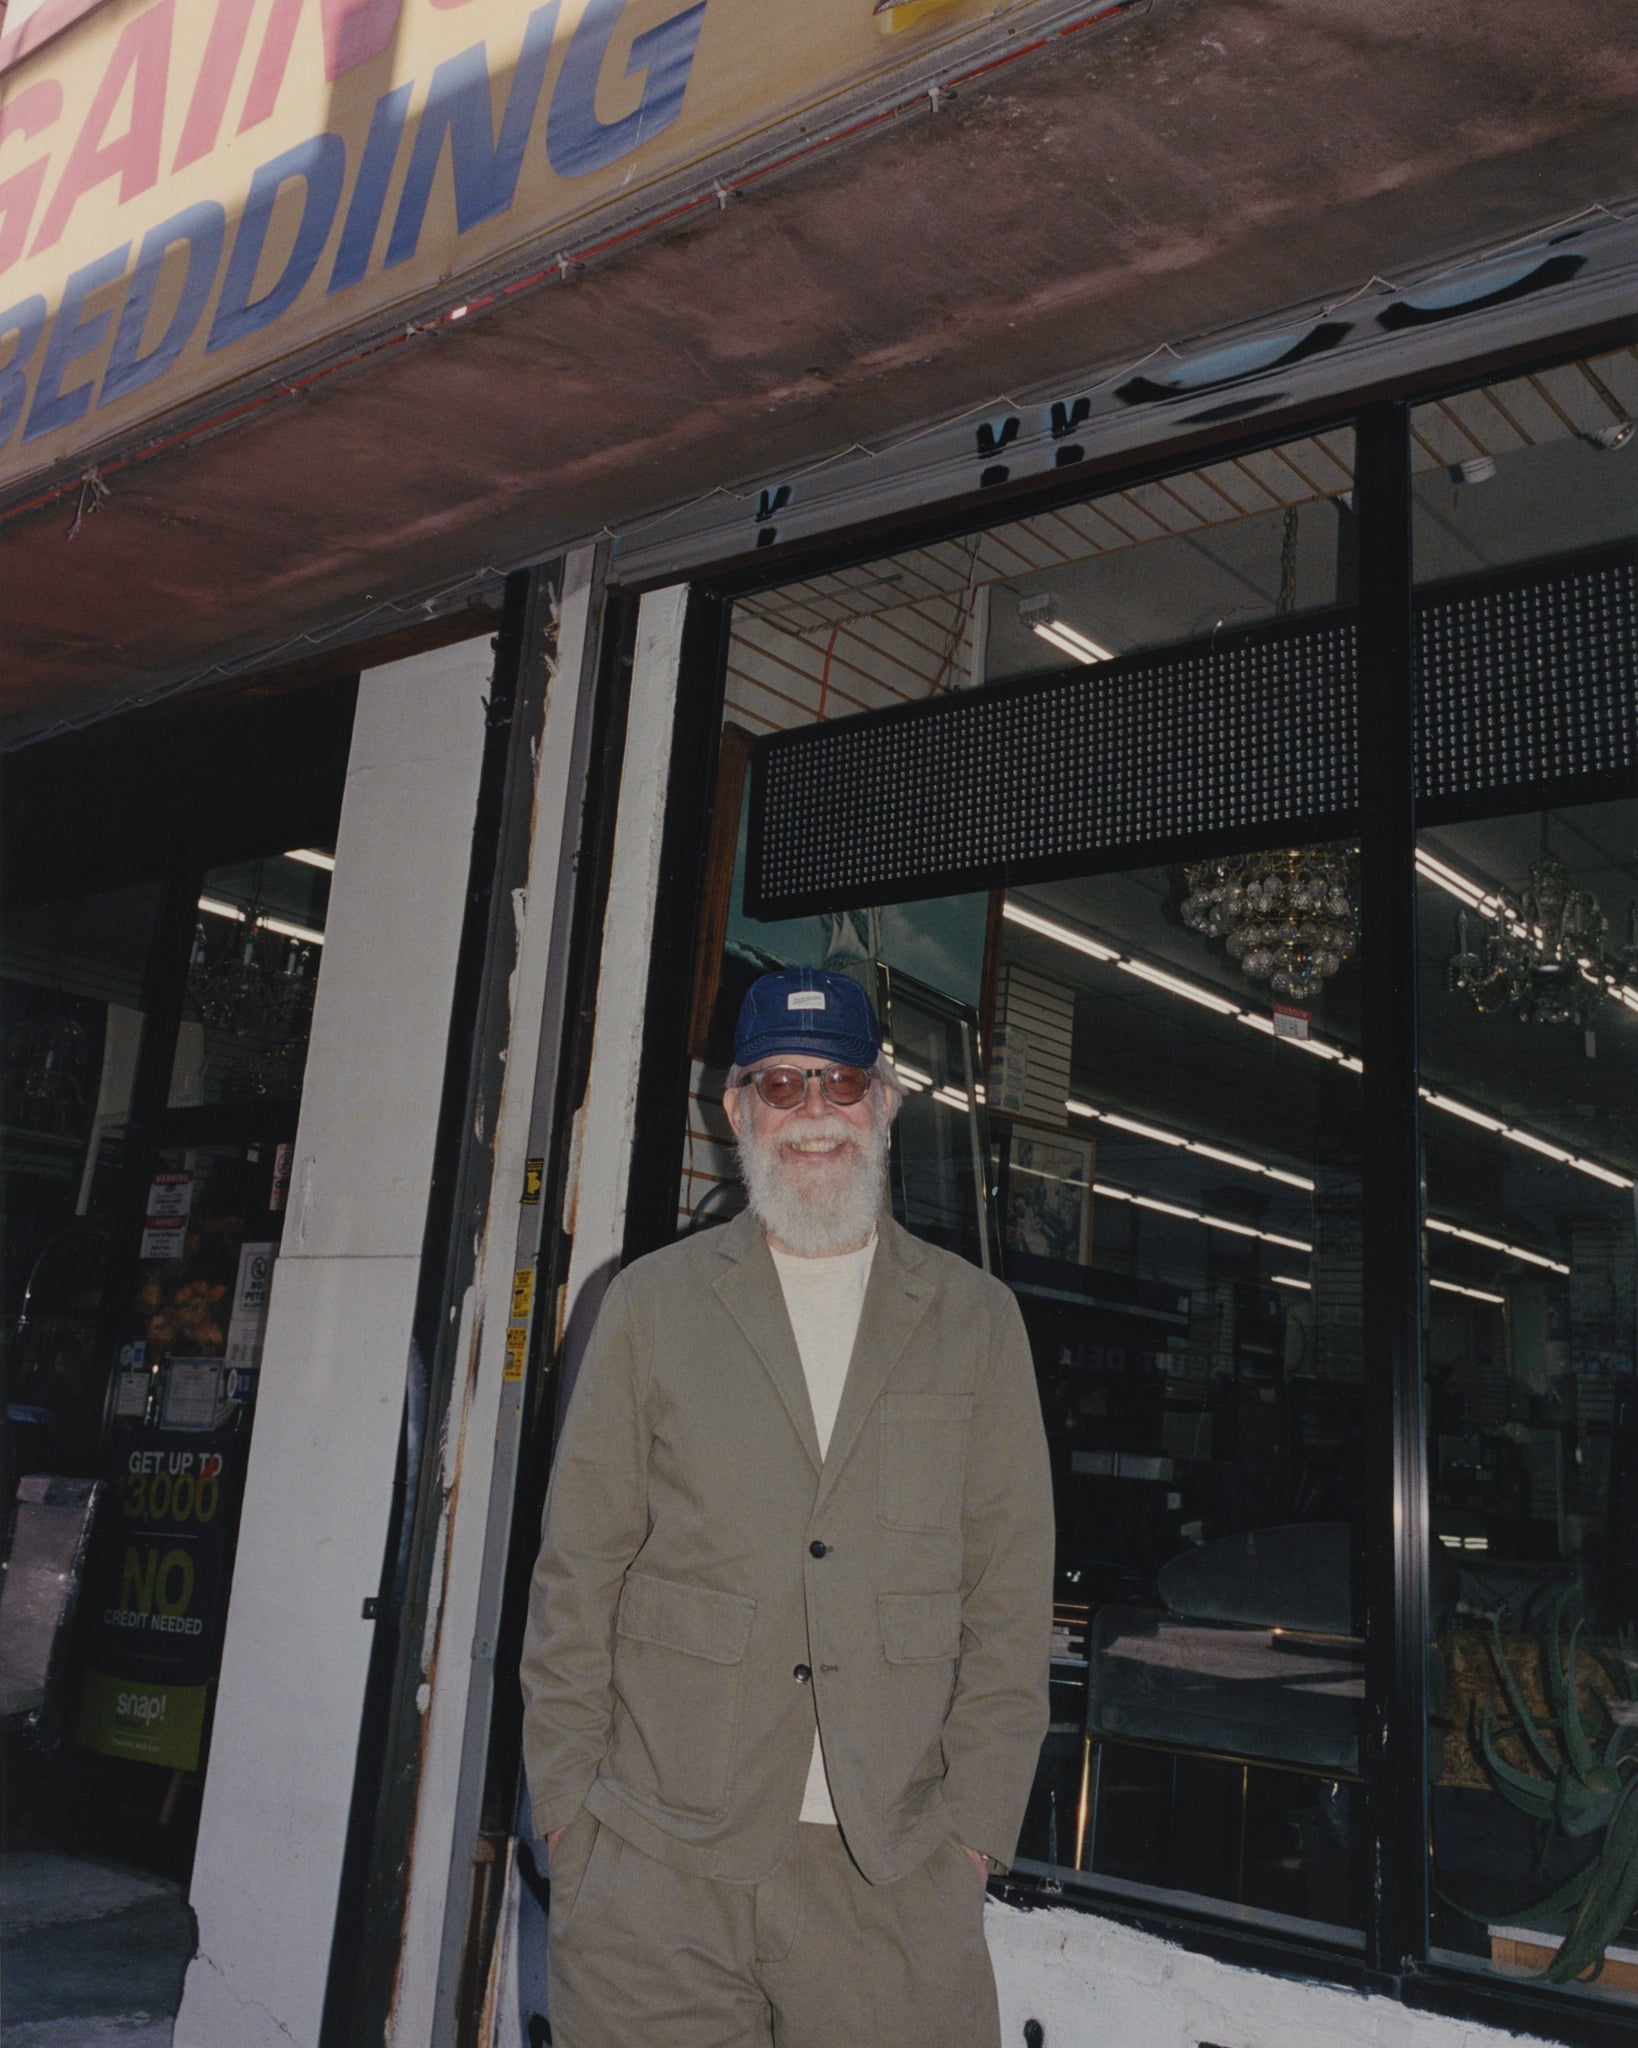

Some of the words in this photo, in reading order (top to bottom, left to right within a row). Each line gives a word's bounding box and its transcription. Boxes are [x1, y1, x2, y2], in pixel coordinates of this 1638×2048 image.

[128, 1451, 165, 1474] GET
[168, 1451, 193, 1475] UP
[198, 1452, 224, 1477] TO
[120, 1546, 195, 1619] NO
[104, 1608, 148, 1631] CREDIT
[151, 1613, 203, 1636] NEEDED
[117, 1691, 167, 1727] snap!
